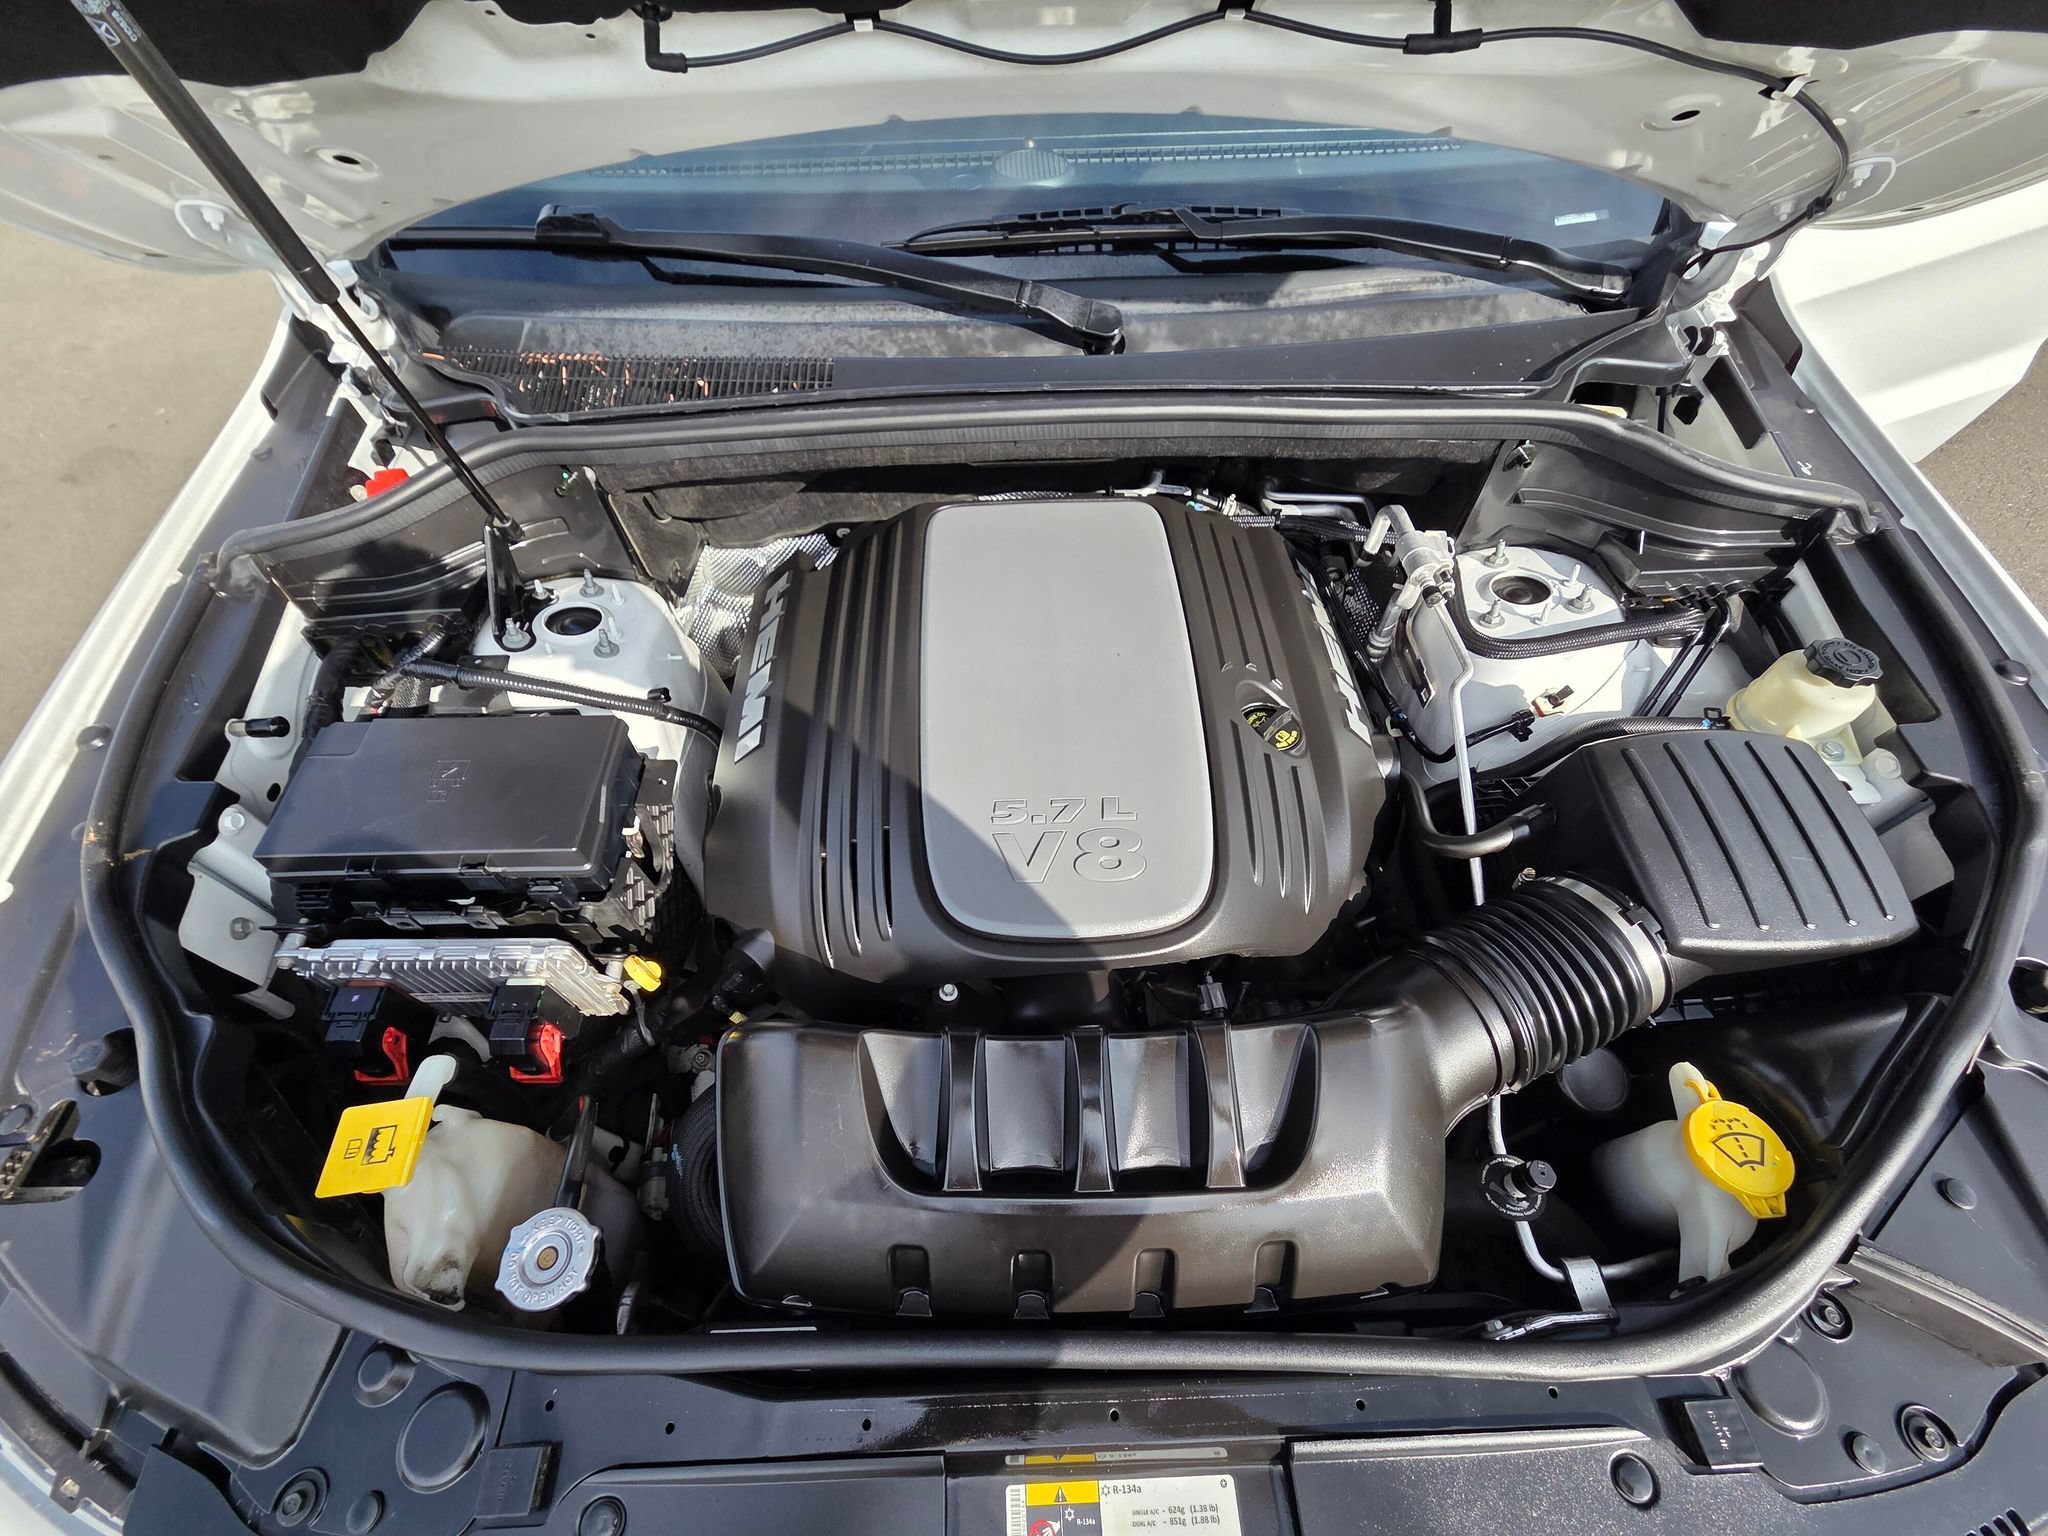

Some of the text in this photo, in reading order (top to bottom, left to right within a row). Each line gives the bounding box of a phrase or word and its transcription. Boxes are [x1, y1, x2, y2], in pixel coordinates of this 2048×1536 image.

[734, 571, 789, 764] HEMI
[991, 827, 1147, 884] V8
[532, 1214, 586, 1245] KEEP TIGHT
[507, 1251, 578, 1304] DO NOT OPEN HOT
[1112, 1484, 1142, 1495] R-134a
[1150, 1508, 1160, 1516] A/C
[1168, 1505, 1186, 1515] 624g
[1190, 1504, 1208, 1514] (1.38
[1209, 1503, 1219, 1513] lb)
[1076, 1517, 1096, 1526] R-134a
[1147, 1520, 1156, 1528] A/C
[1169, 1516, 1187, 1526] 851g
[1191, 1515, 1210, 1526] (1.88
[1210, 1514, 1221, 1525] lb)
